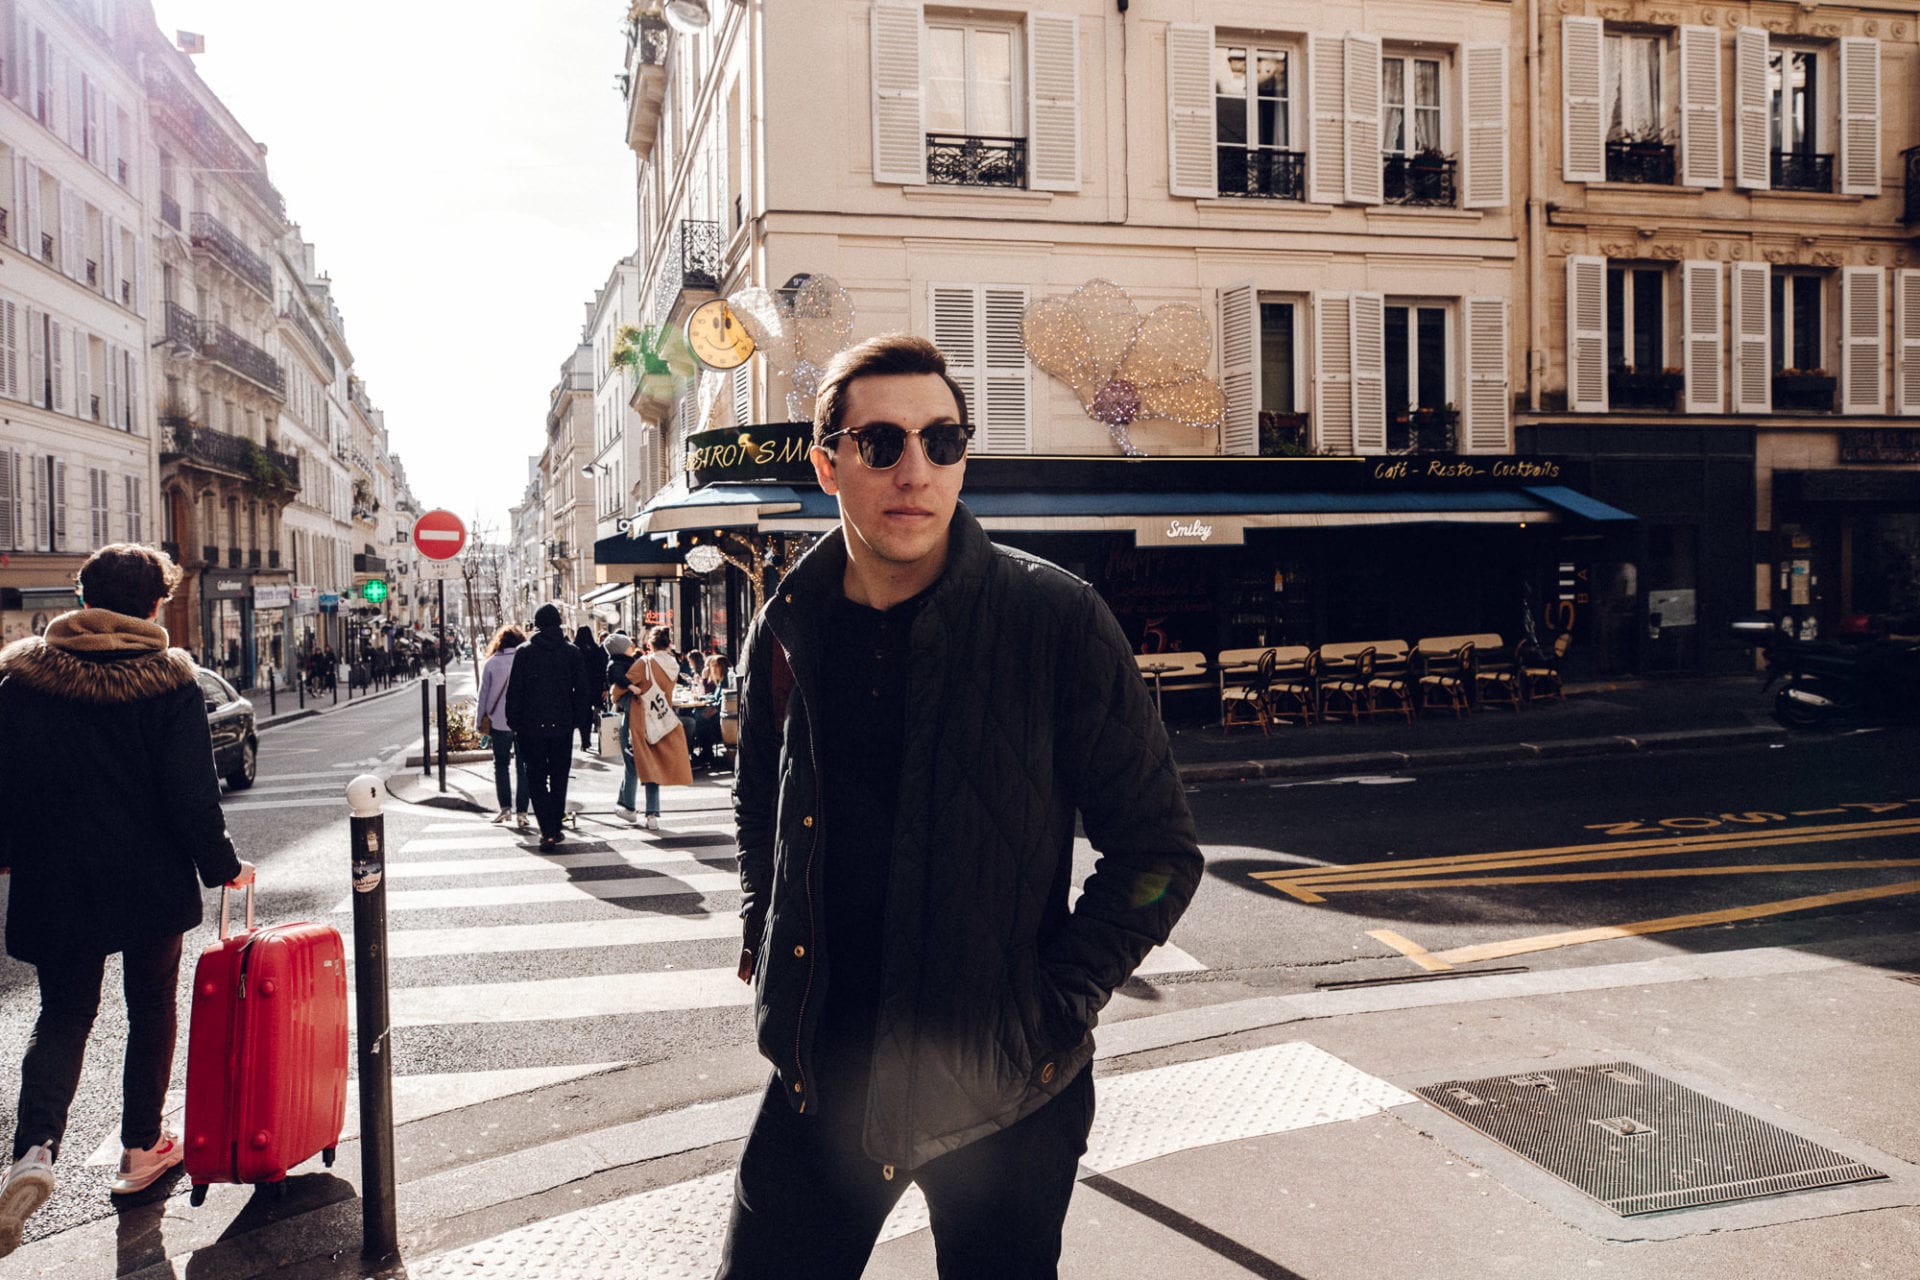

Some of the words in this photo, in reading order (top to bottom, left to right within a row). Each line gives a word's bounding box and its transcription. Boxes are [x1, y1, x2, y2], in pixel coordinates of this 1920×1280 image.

[754, 437, 813, 465] SMI
[1374, 461, 1409, 480] Café
[1427, 459, 1475, 478] Resto
[1492, 460, 1561, 478] Cocktails
[1166, 518, 1213, 542] Smiley
[650, 693, 665, 712] 15
[1584, 799, 1920, 835] AISON
